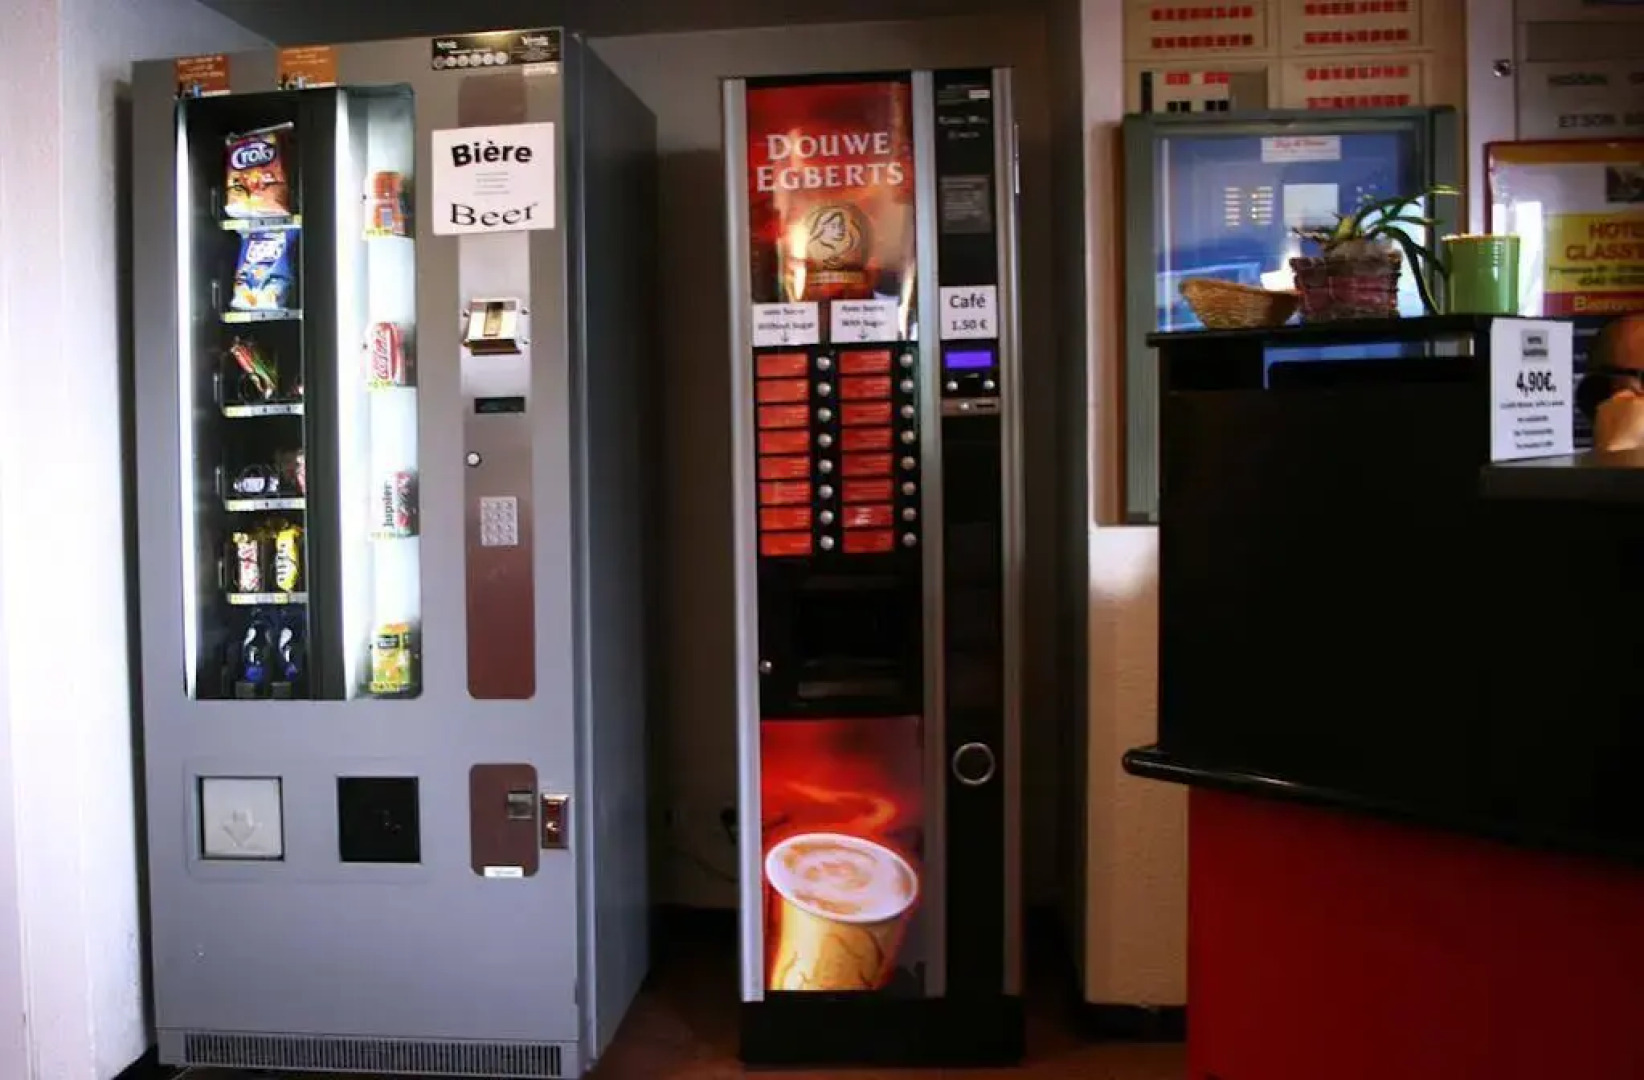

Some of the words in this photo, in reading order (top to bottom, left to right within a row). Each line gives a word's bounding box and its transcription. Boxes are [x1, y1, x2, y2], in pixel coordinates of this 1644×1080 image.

[451, 140, 533, 168] Bière
[767, 131, 890, 160] DOUWE
[756, 162, 904, 191] EGBERTS
[449, 202, 540, 227] Beer
[949, 292, 987, 309] Café
